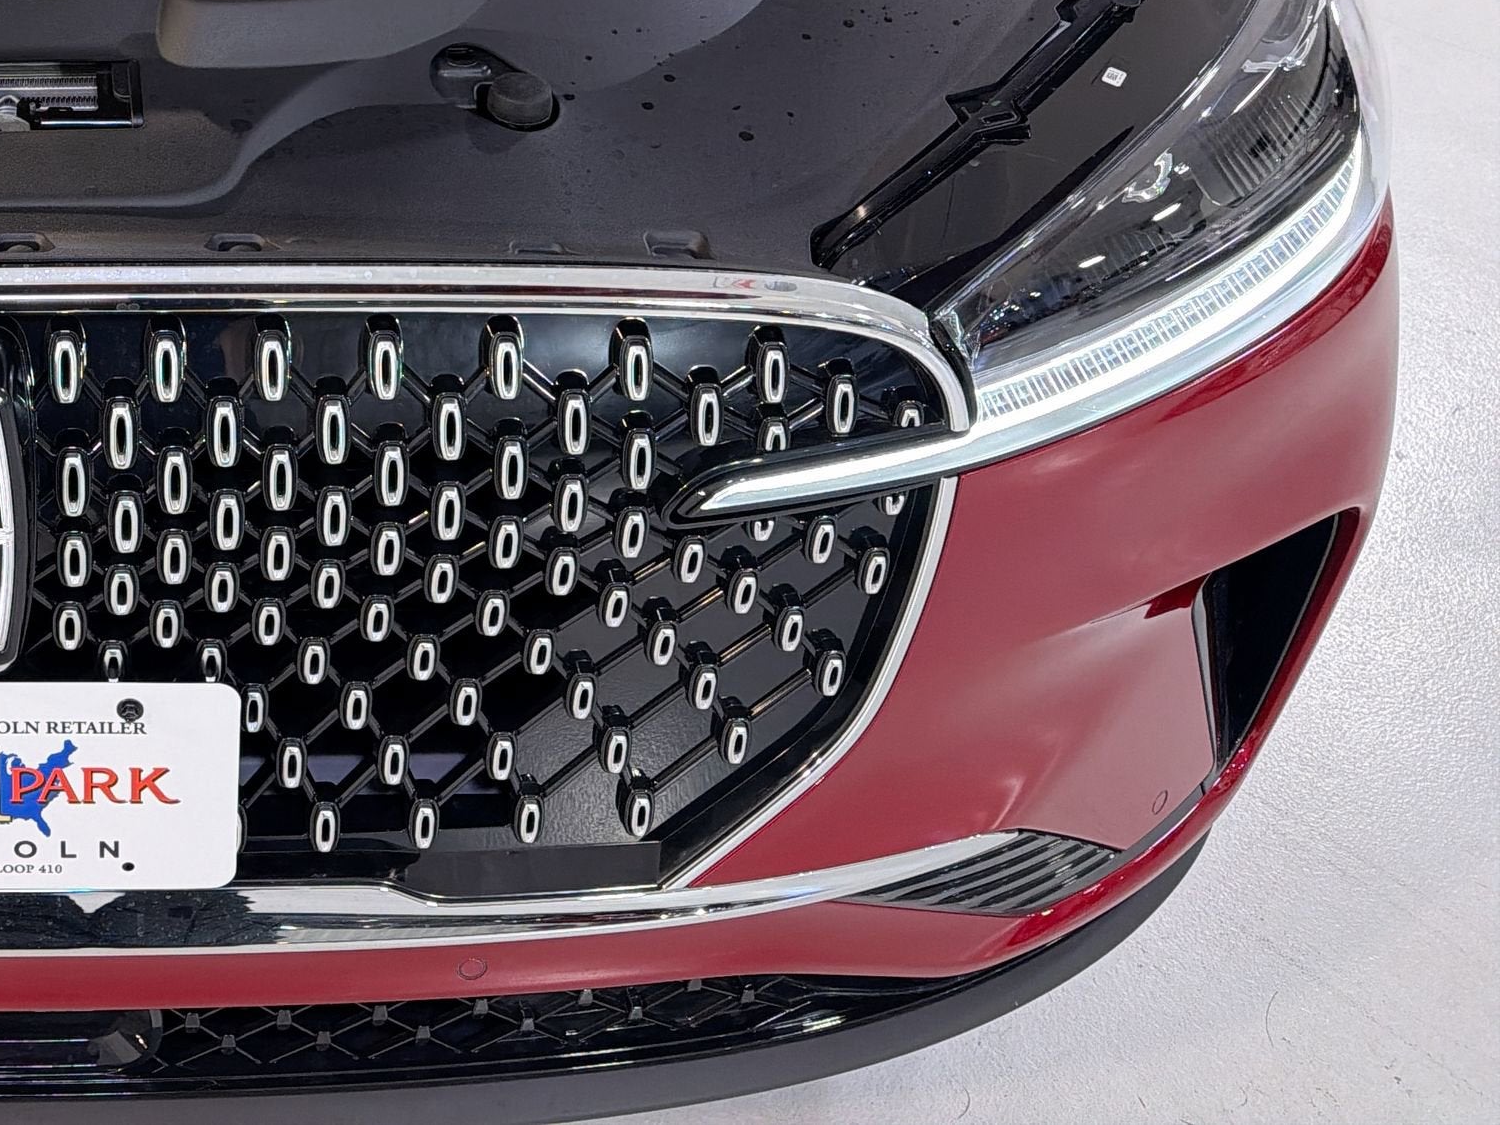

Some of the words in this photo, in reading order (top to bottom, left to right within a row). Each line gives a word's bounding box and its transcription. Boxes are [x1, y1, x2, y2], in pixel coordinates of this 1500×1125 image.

[44, 720, 148, 736] RETAILER
[10, 766, 181, 805] PARK
[38, 863, 62, 874] 410
